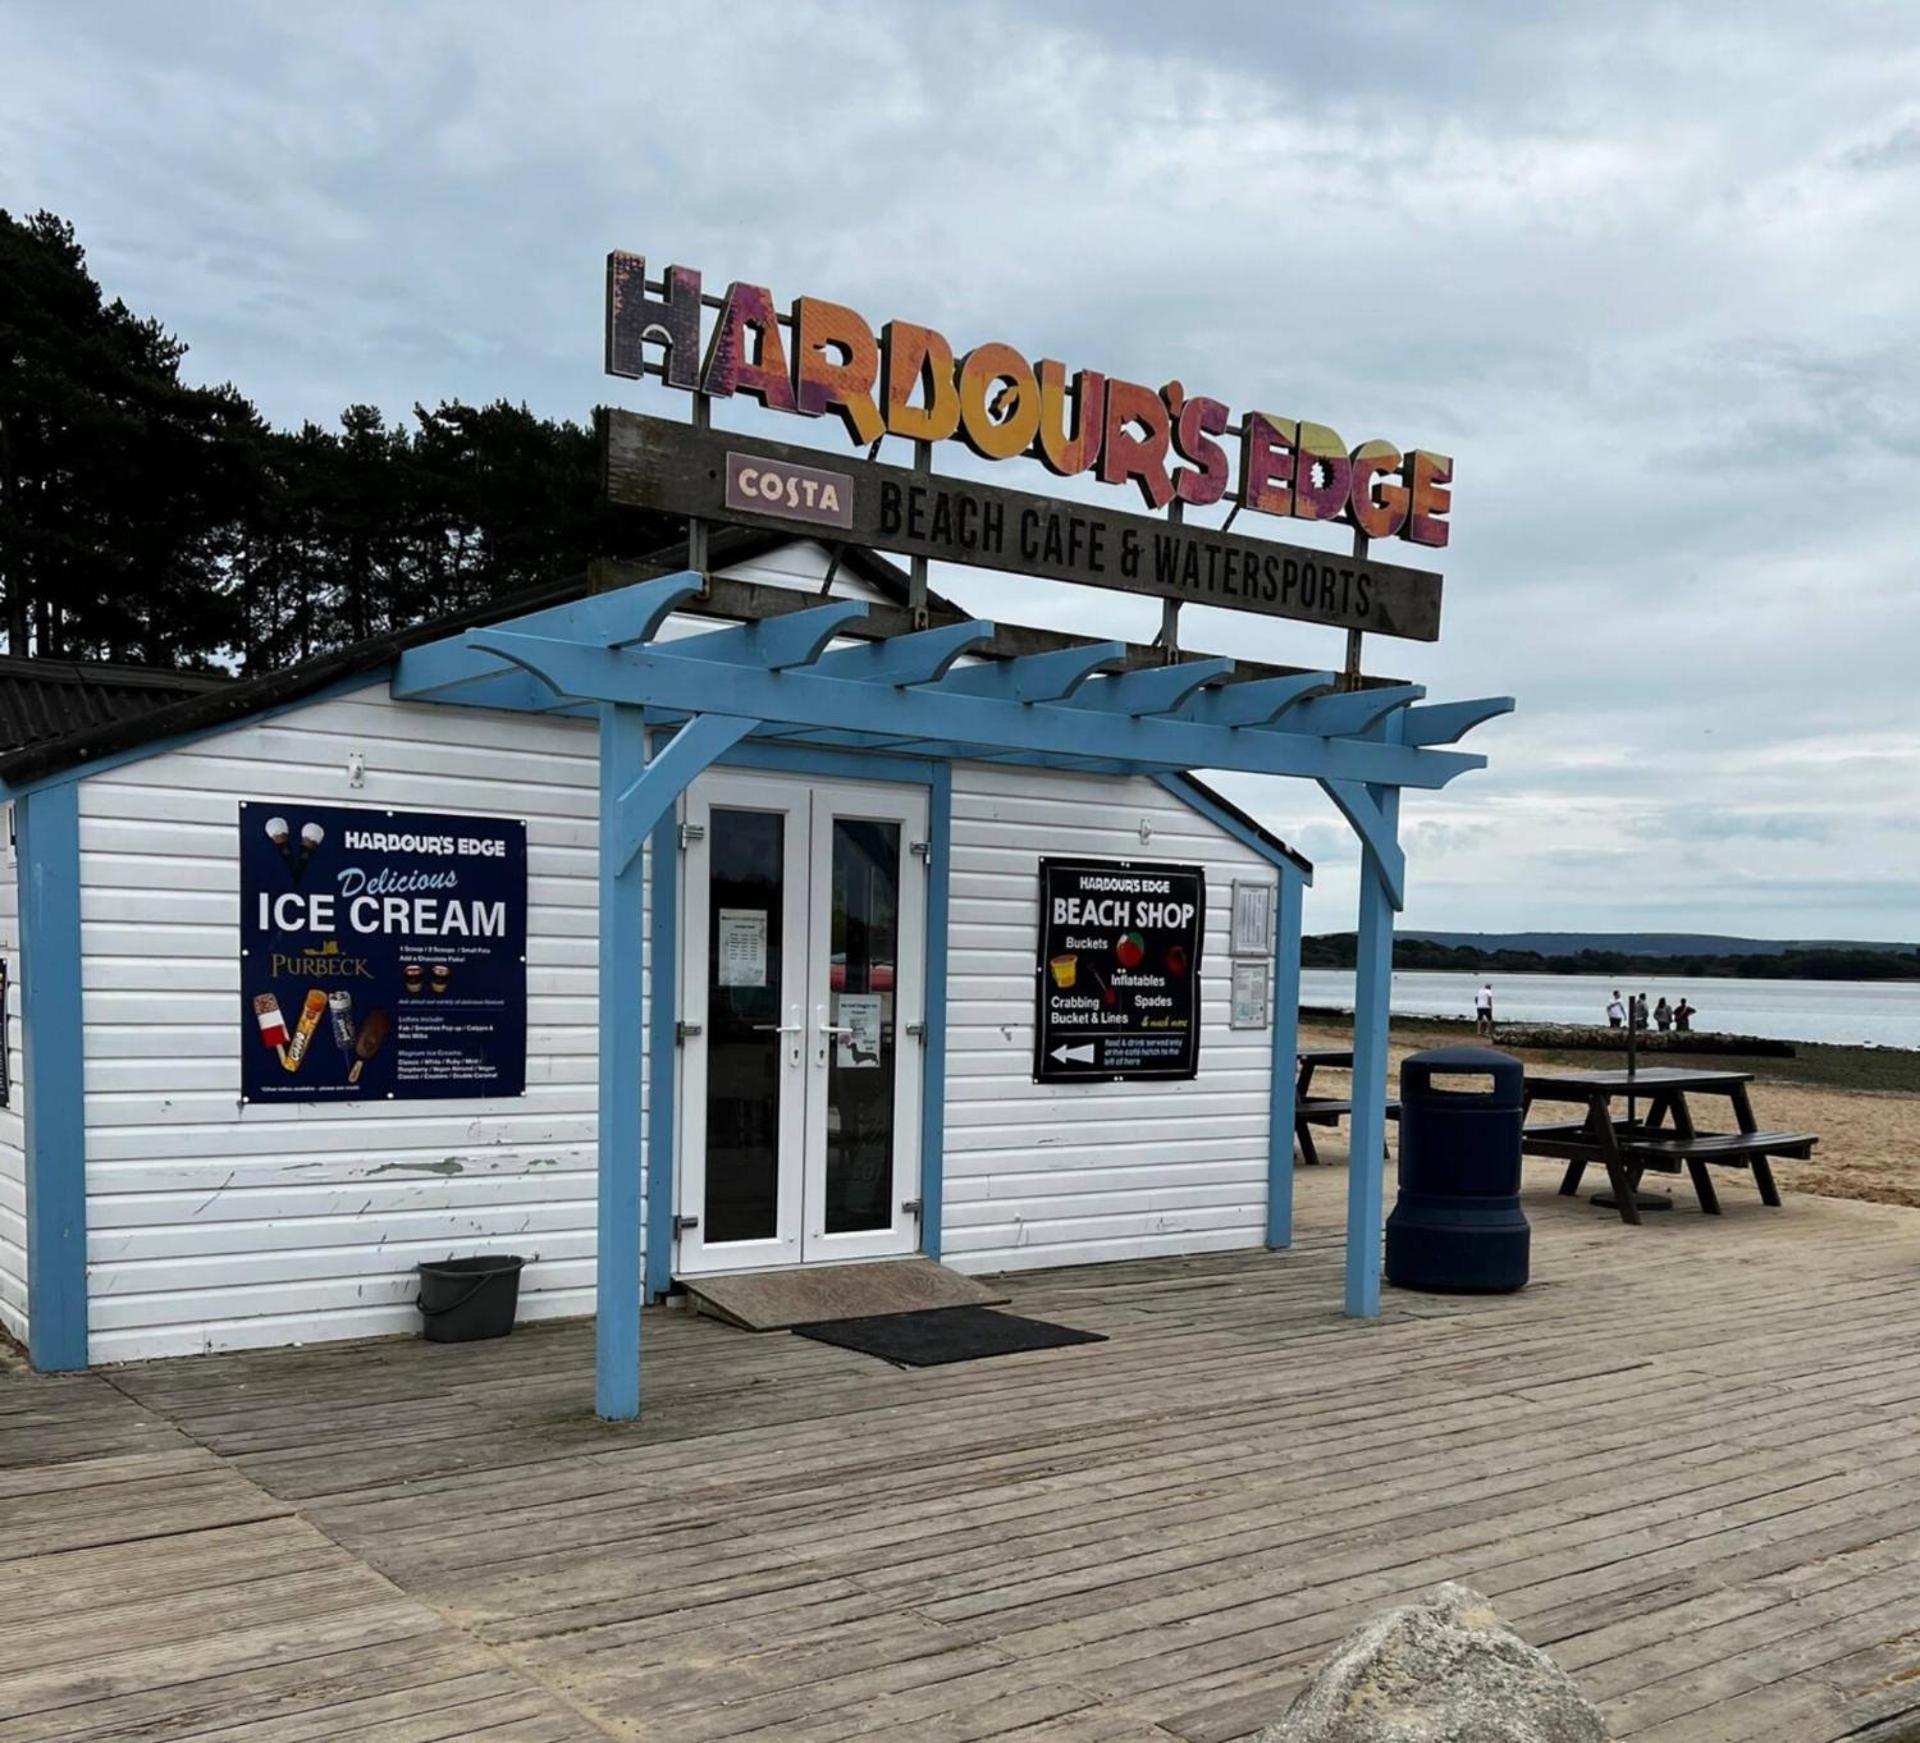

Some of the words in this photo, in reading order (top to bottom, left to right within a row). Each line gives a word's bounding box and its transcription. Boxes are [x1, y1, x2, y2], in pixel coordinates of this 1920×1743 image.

[737, 468, 840, 512] COSTA
[1240, 411, 1454, 547] EDGE
[880, 480, 1003, 553] BEACH
[1020, 508, 1105, 572] CAFE
[1120, 529, 1143, 579] &
[1155, 533, 1371, 617] WATERSPORTS
[344, 831, 454, 856] HARBOUR'S
[458, 838, 506, 857] EDGE
[337, 867, 458, 898] Delicious
[1080, 876, 1140, 894] HARBOUR'S
[1142, 880, 1170, 894] EDGE
[258, 892, 335, 932] ICE
[350, 896, 506, 937] CREAM
[1053, 898, 1130, 927] BEACH
[1136, 901, 1195, 929] SHOP
[1065, 937, 1109, 950] Buckets
[1110, 974, 1165, 987] Inflatables
[1051, 996, 1100, 1010] Crabbing
[1134, 996, 1172, 1008] Spades
[1051, 1012, 1088, 1024] Bucket
[1091, 1012, 1098, 1024] &
[1101, 1012, 1128, 1024] Lines
